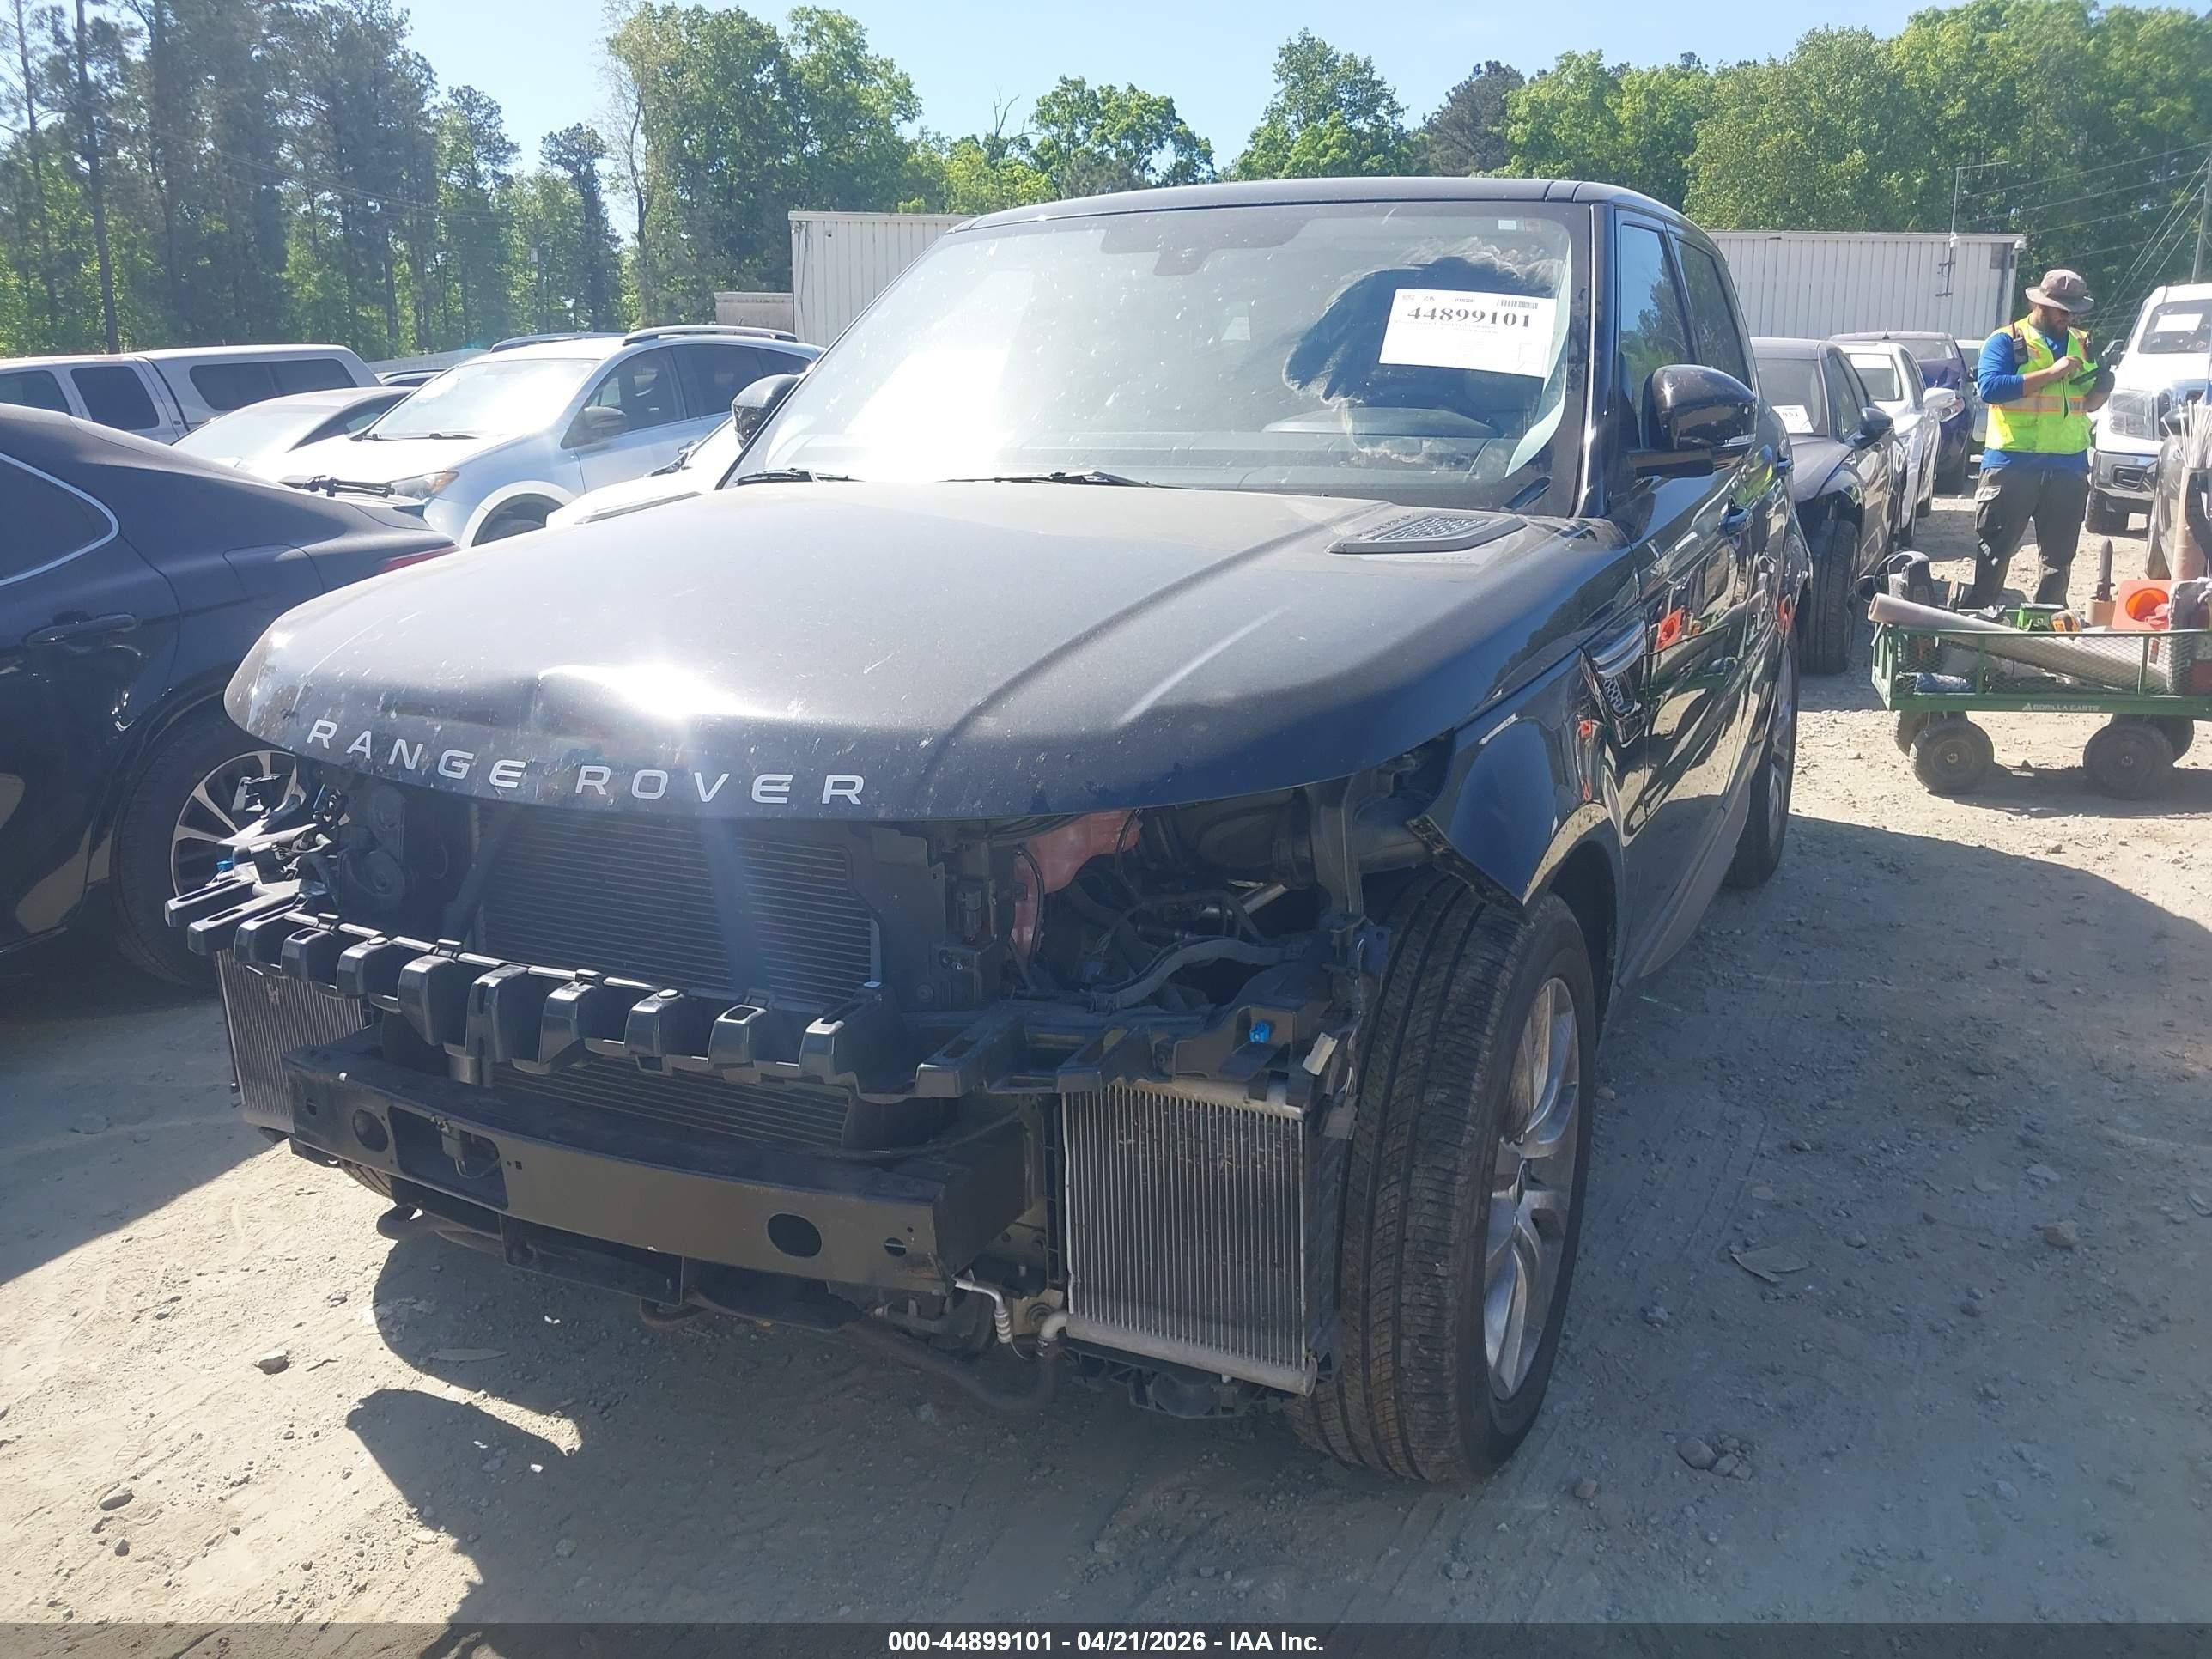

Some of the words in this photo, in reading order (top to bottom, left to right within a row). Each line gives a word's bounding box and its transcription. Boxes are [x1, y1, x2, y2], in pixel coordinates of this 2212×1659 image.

[1407, 307, 1530, 328] 44899101
[307, 719, 526, 788] RANGE
[574, 765, 865, 805] ROVER
